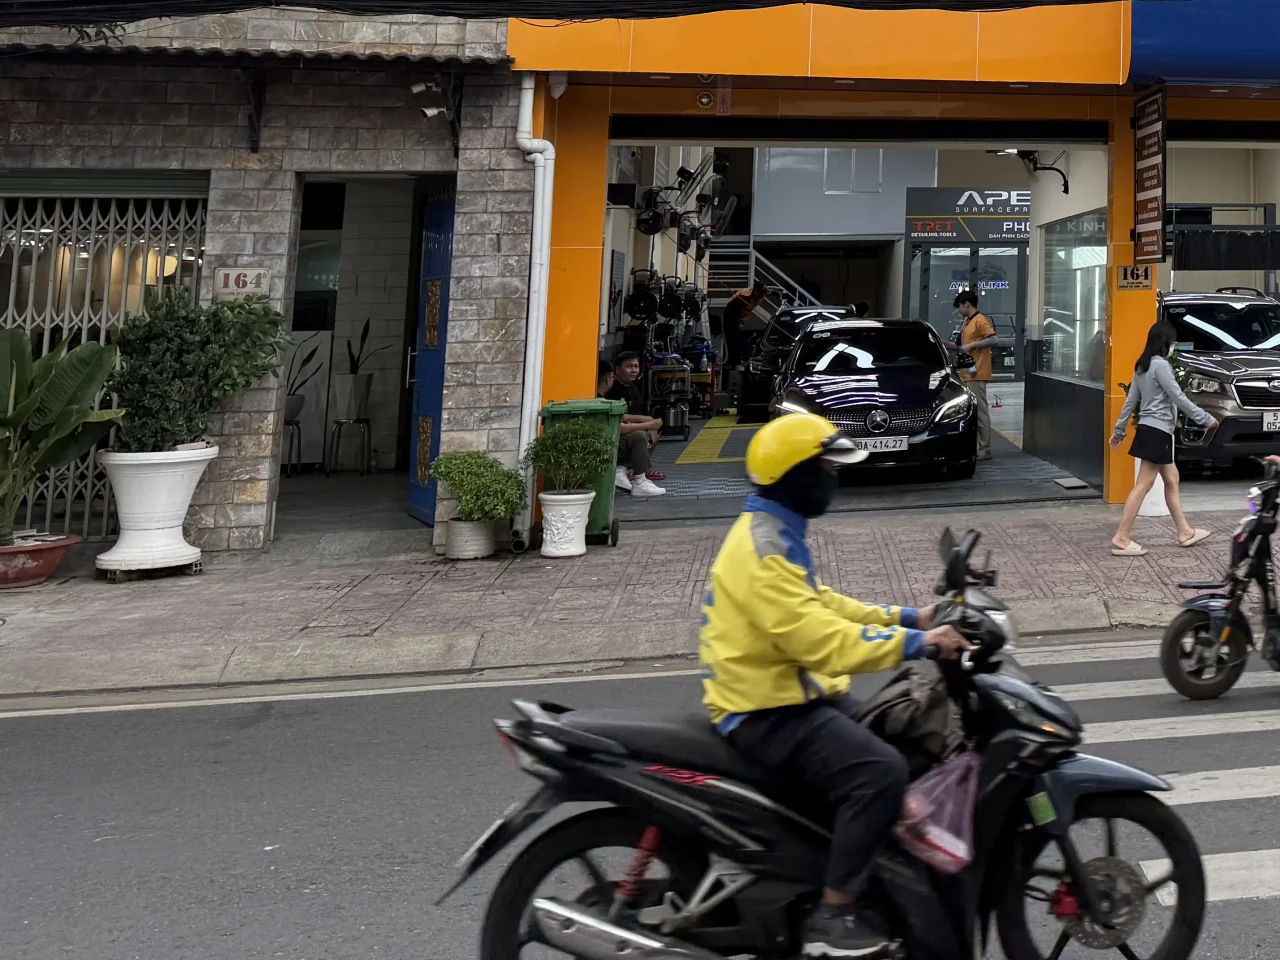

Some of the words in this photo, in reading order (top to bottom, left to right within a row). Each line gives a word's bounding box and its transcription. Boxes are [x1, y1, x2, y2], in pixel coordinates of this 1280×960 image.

[956, 190, 1031, 205] APE
[912, 221, 956, 232] TPET
[1122, 266, 1150, 281] 164
[949, 280, 1009, 291] AUOLINK
